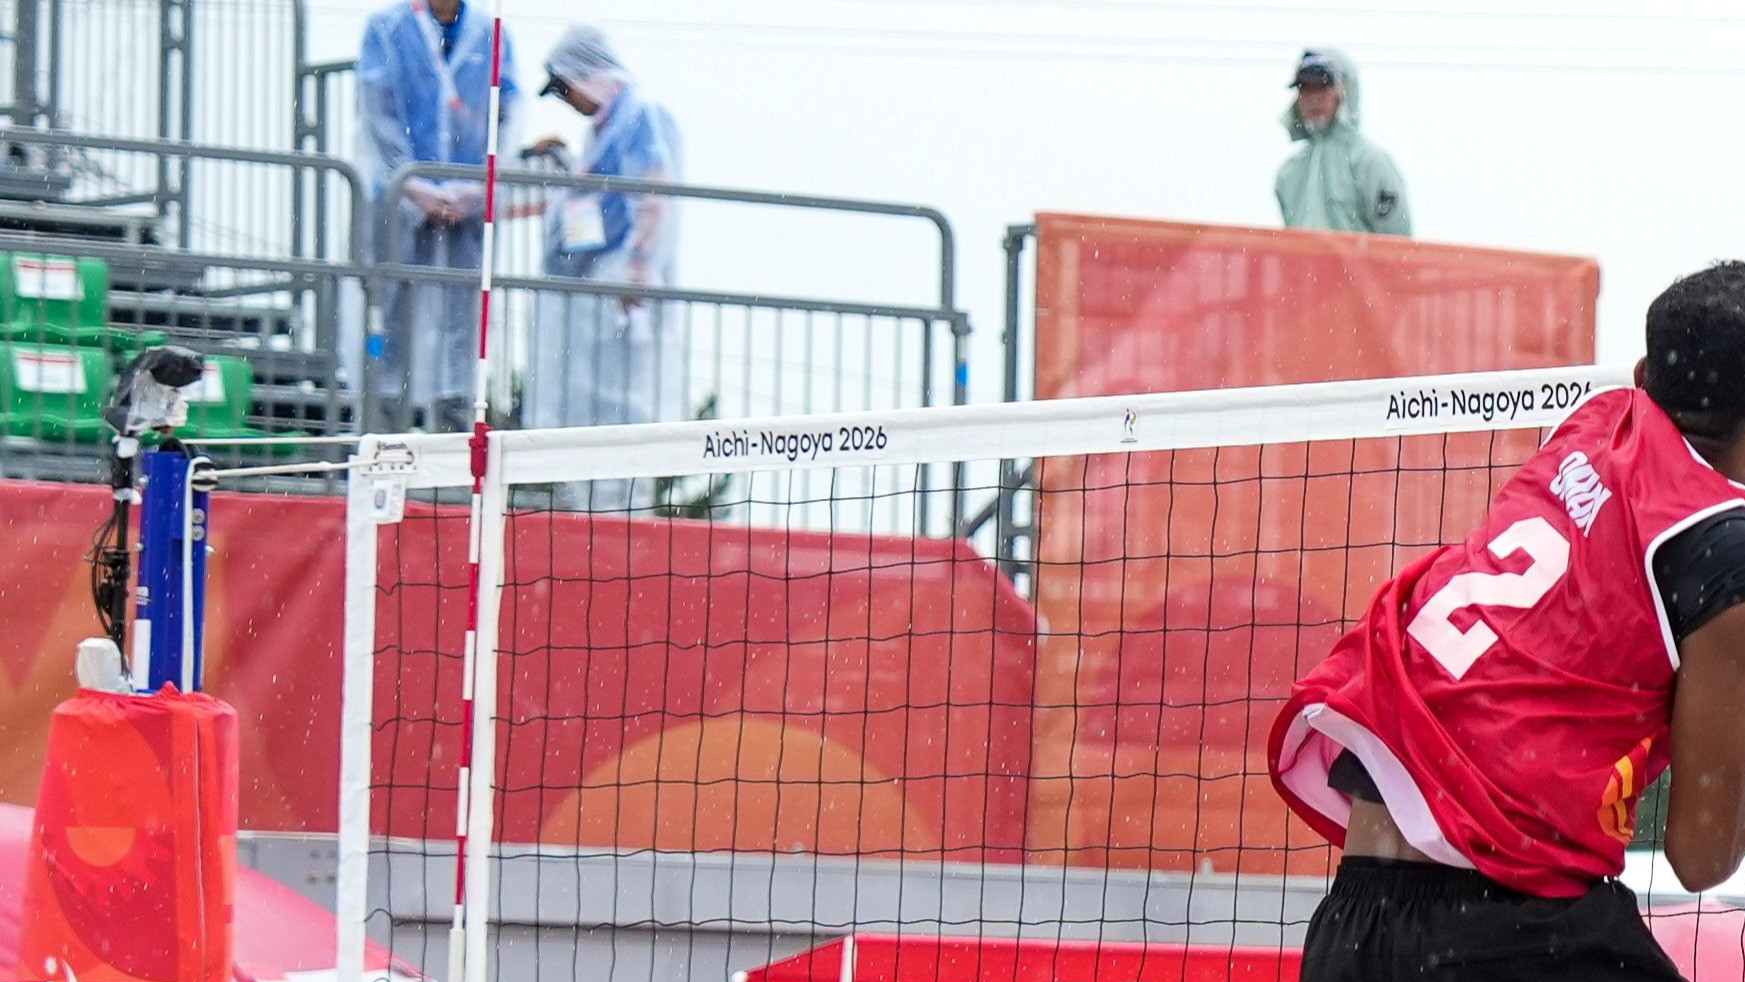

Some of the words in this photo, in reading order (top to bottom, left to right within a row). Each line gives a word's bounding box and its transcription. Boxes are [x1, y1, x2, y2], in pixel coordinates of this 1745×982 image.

[1386, 388, 1535, 422] Aichi-Nagoya
[703, 429, 833, 462] Aichi-Nagoya
[839, 425, 887, 451] 2026
[1406, 516, 1571, 681] 2
